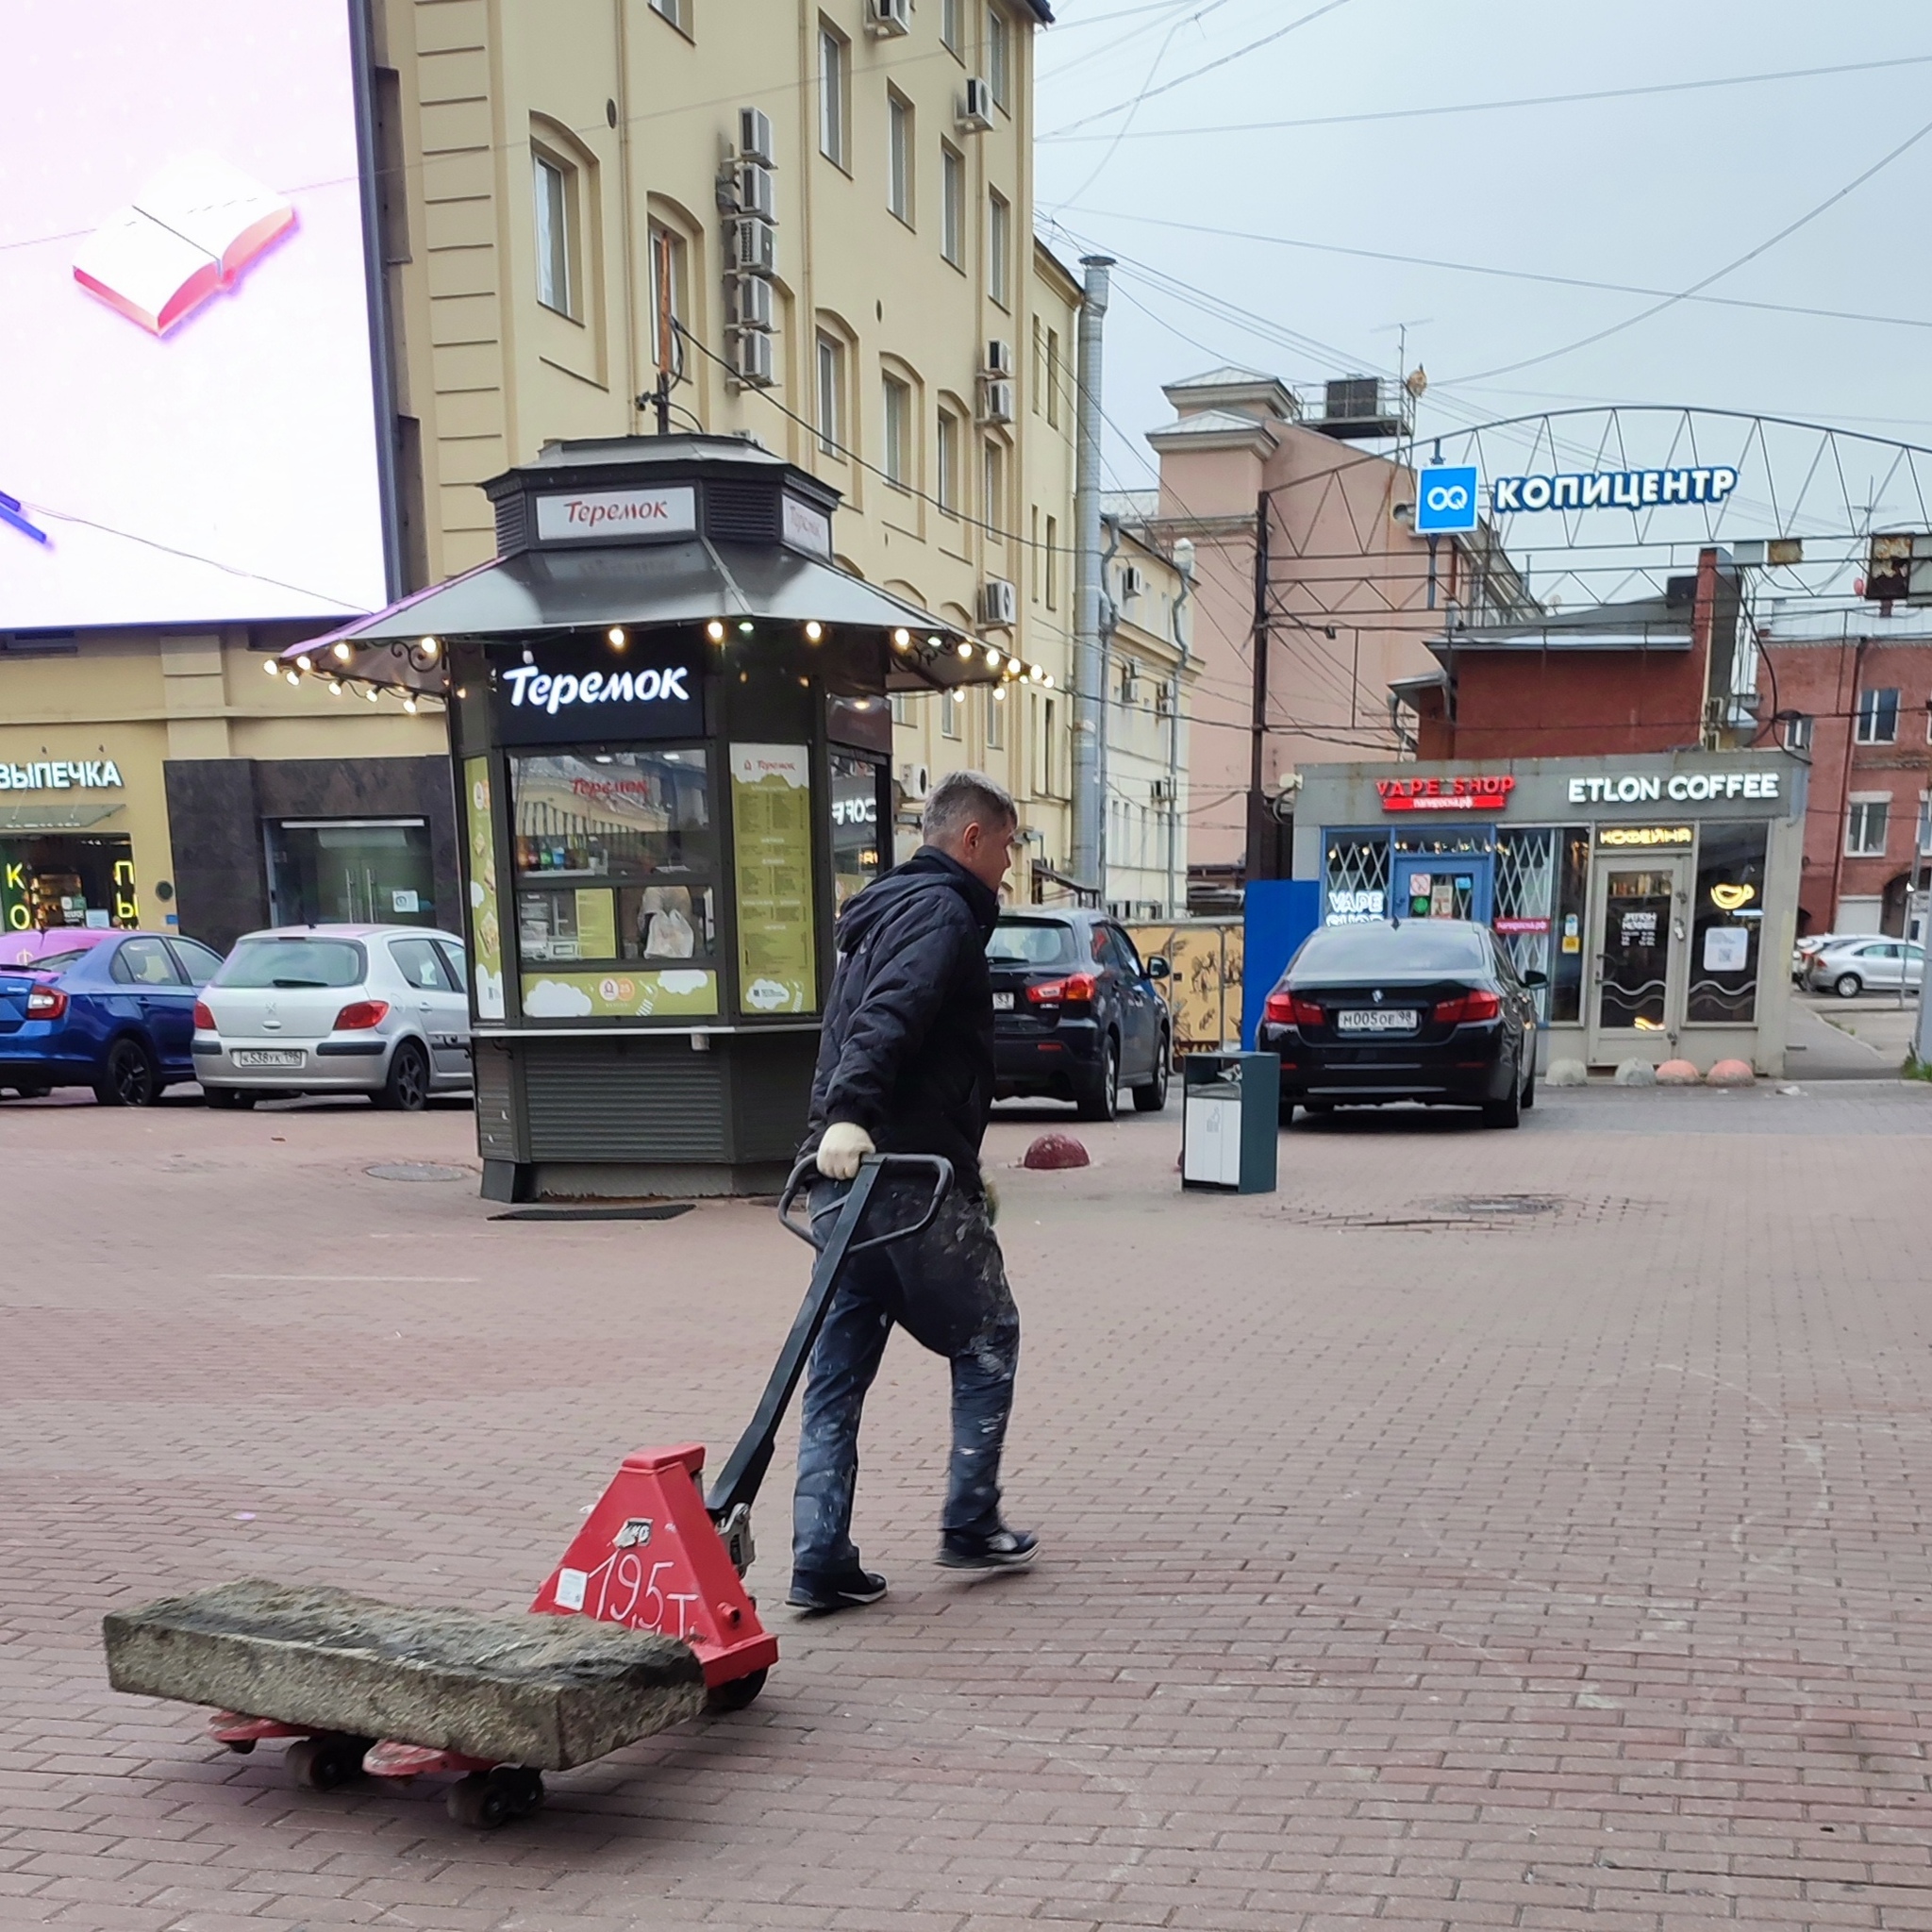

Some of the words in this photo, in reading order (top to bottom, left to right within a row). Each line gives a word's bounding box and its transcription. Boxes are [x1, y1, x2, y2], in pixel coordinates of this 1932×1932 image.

[1496, 468, 1737, 509] КОПИЦЕНТР
[564, 500, 669, 526] Теремок
[503, 665, 690, 714] Теремок
[1376, 778, 1441, 795] VAPE
[1453, 775, 1515, 794] SHOP
[1569, 776, 1659, 802] ETLON
[1668, 773, 1779, 800] COFFEE
[1328, 891, 1384, 912] VAPE
